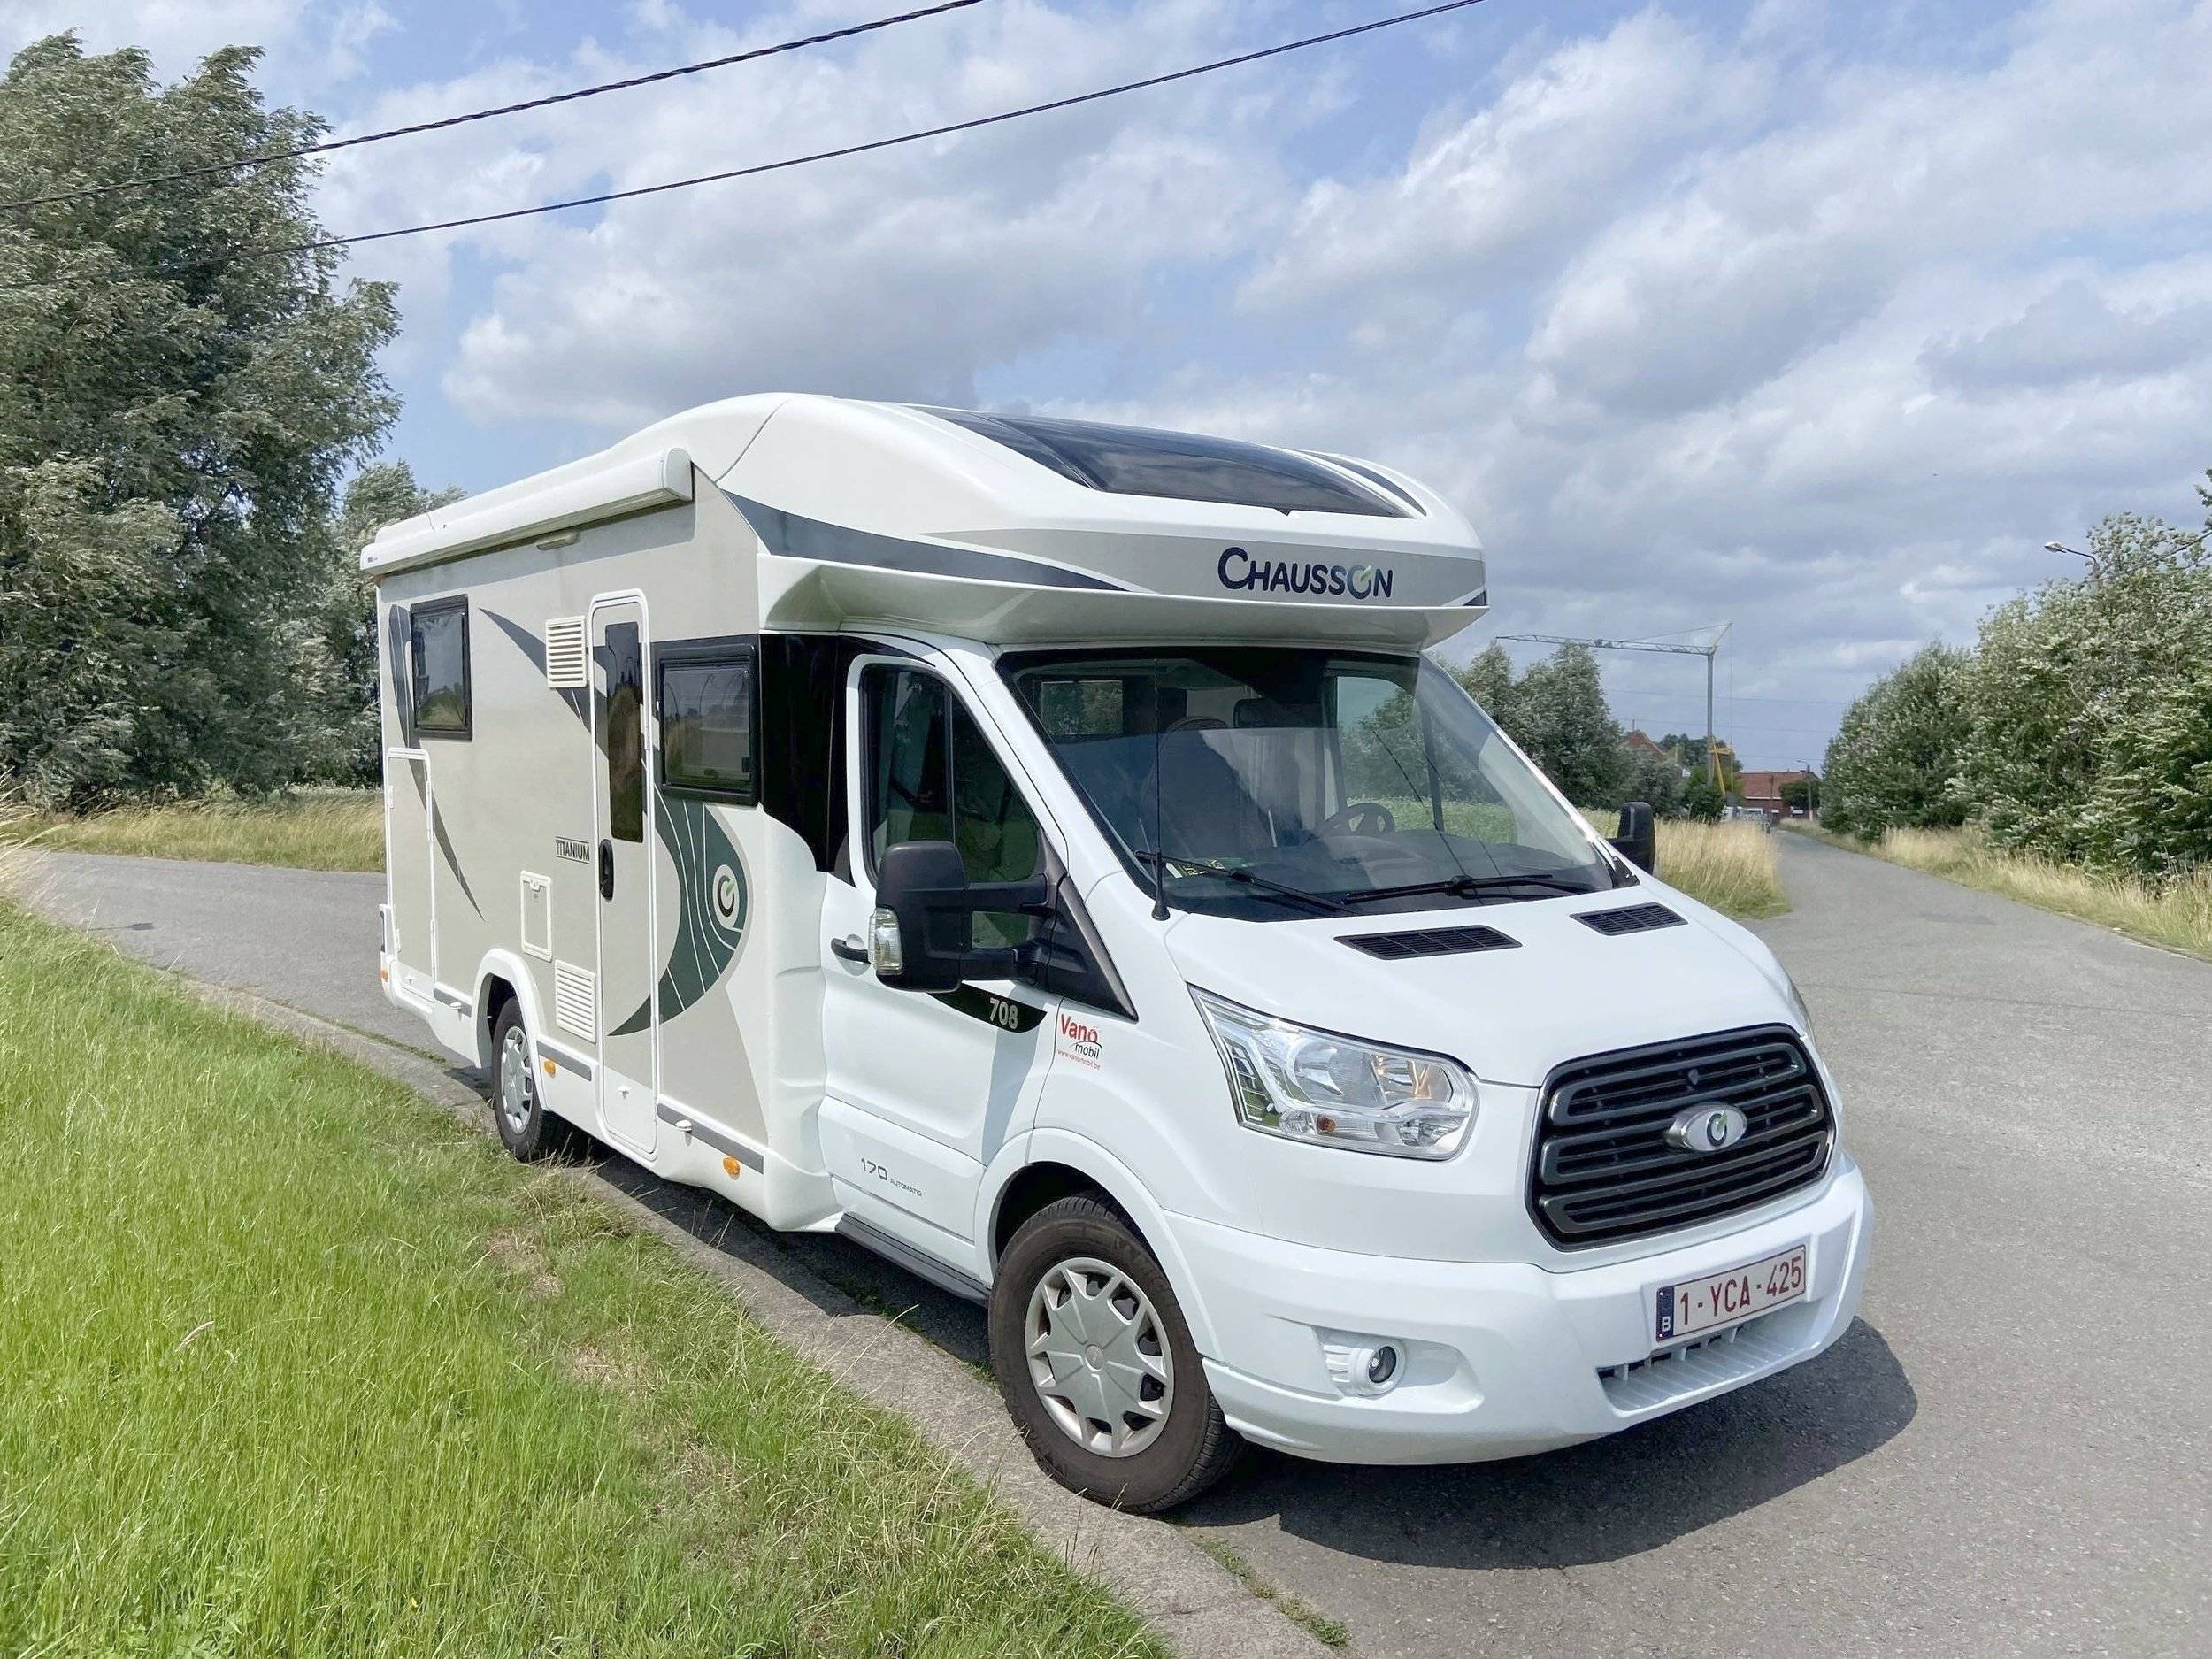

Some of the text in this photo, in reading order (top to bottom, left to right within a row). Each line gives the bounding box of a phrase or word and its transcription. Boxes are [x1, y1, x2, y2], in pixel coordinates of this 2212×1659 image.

[1217, 546, 1394, 600] CHAUSSON
[555, 839, 590, 862] TITANIUM
[989, 997, 1018, 1030] 708
[1060, 1013, 1098, 1042] Vano
[1074, 1042, 1101, 1060] mobil
[861, 1157, 887, 1181] 170
[1661, 1315, 1671, 1333] B
